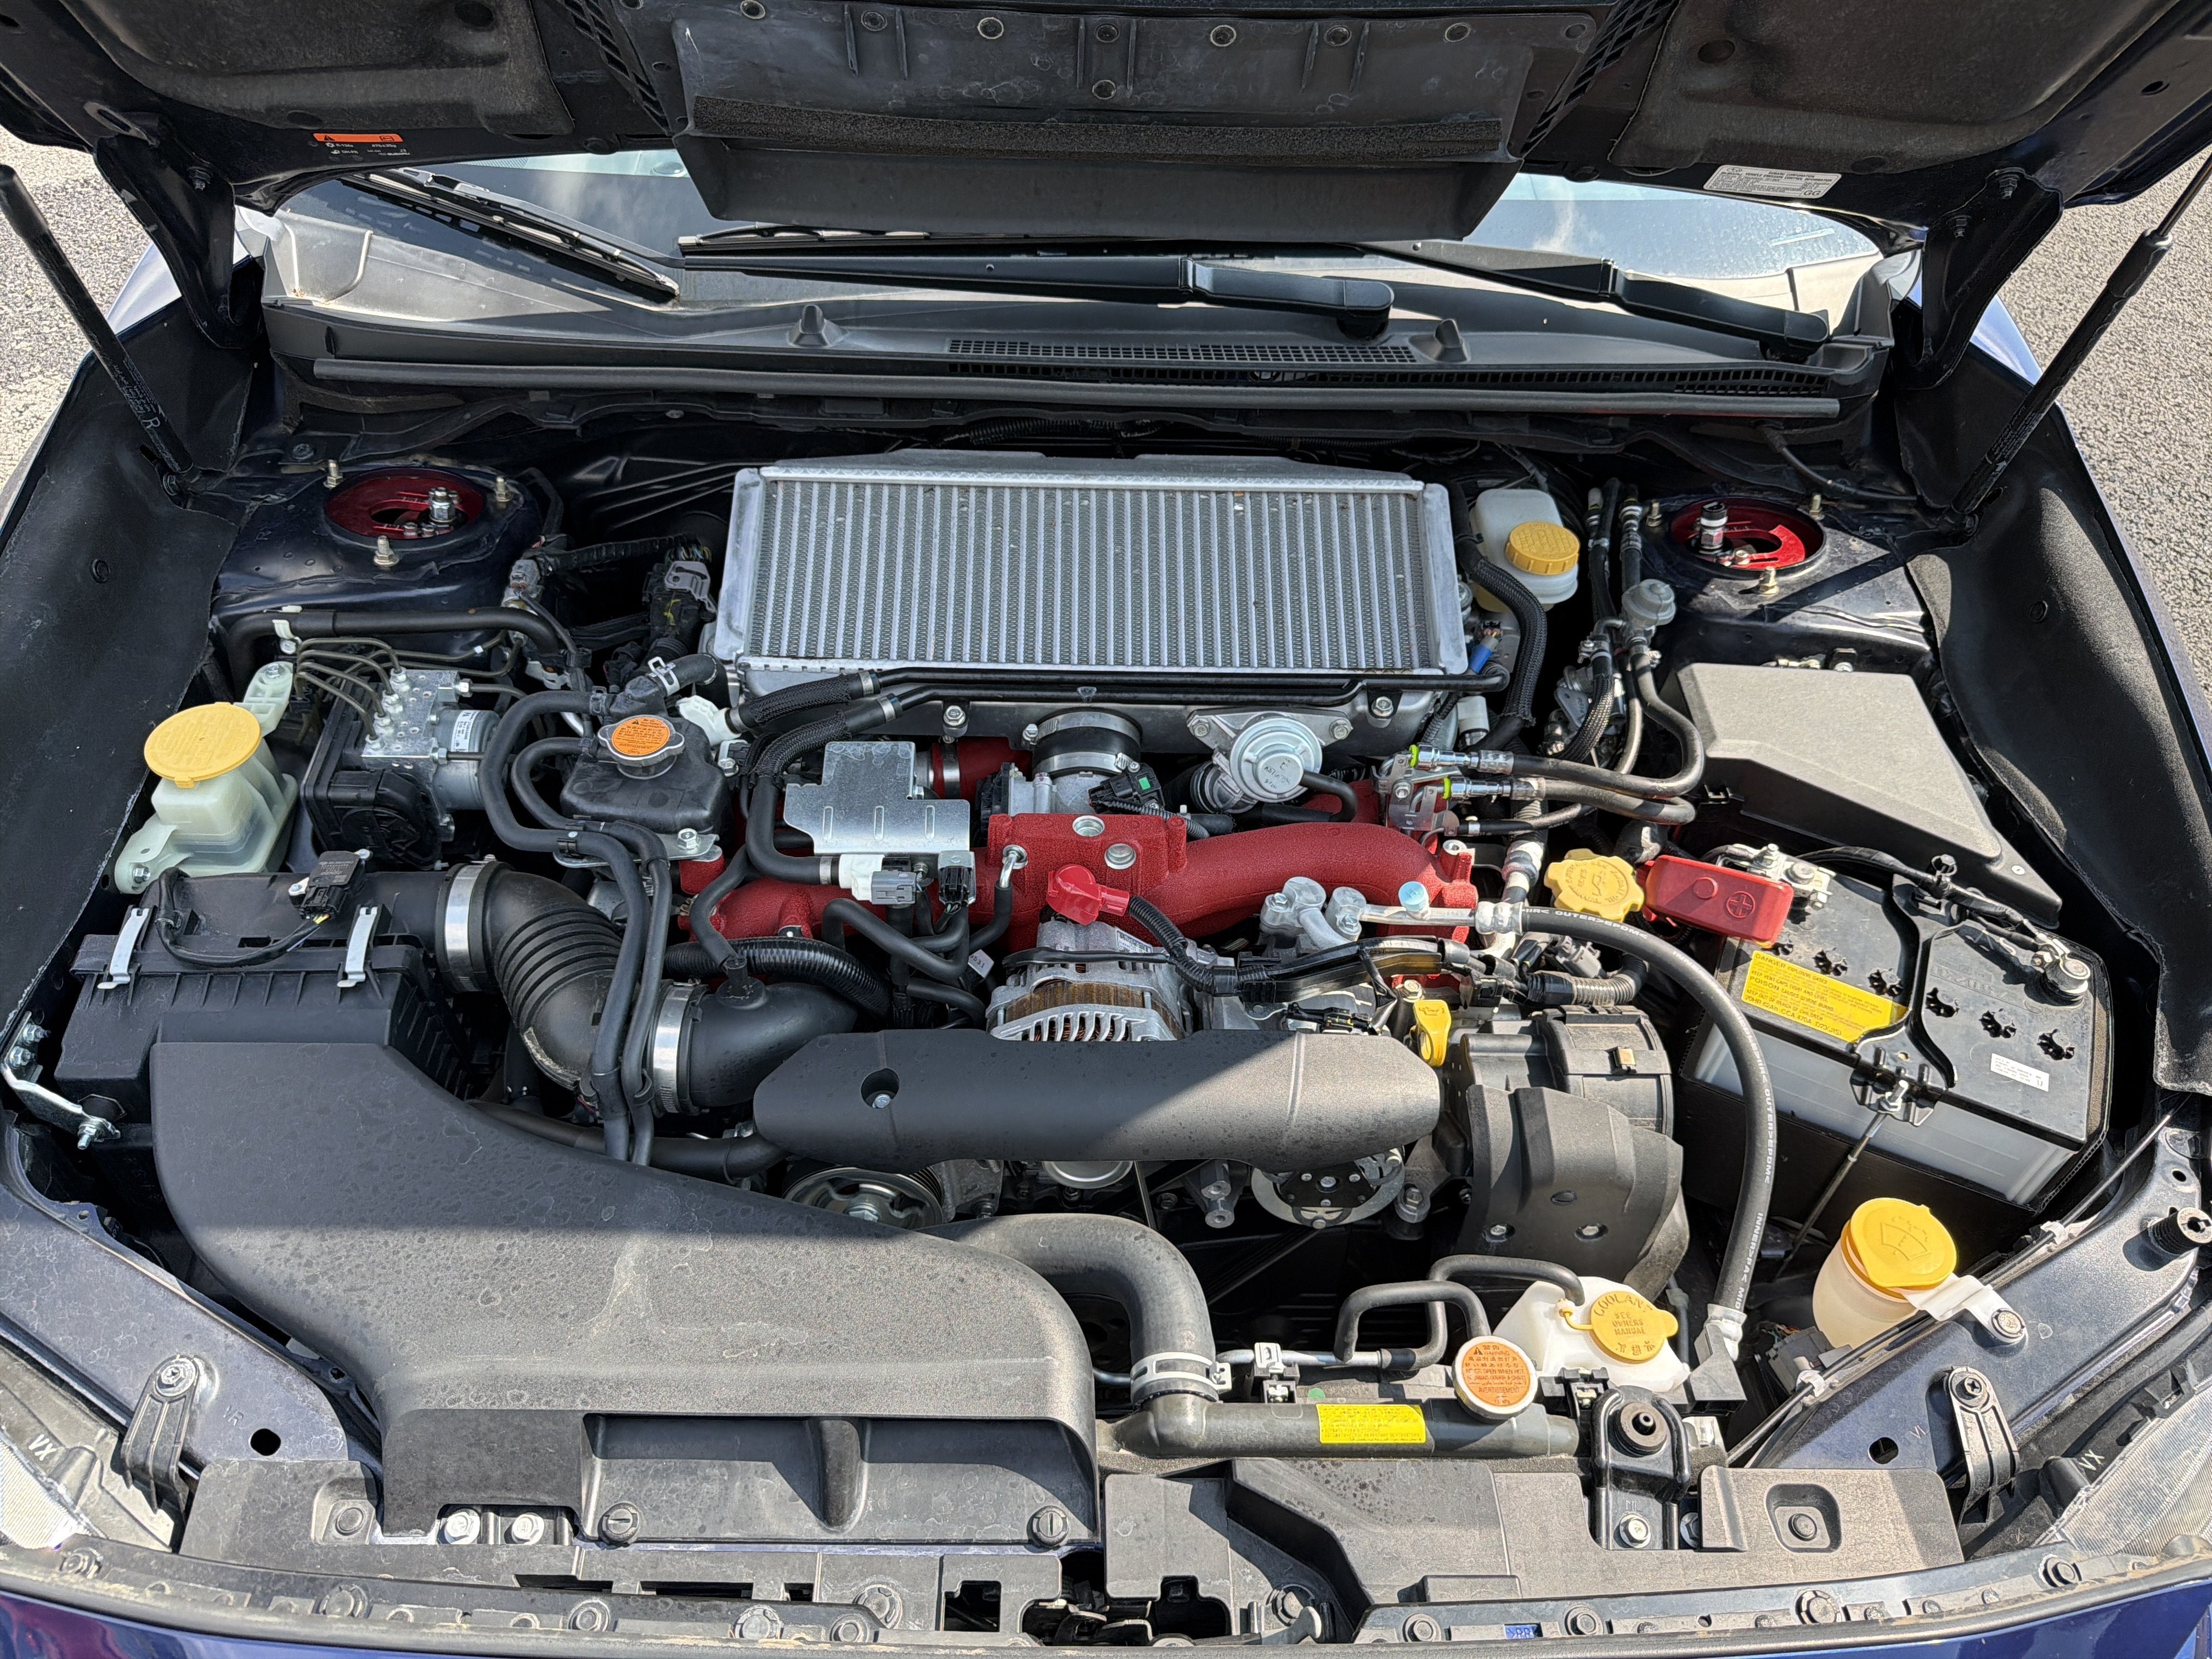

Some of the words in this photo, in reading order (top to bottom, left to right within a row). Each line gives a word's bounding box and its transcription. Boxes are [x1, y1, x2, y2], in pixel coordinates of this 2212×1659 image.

[1756, 953, 1786, 968] DANGER
[1750, 976, 1779, 990] POISON
[1781, 1008, 1795, 1018] CCA
[1764, 1088, 1775, 1184] OUTER>EPDM<
[1741, 1211, 1764, 1283] INNER>PA<
[1593, 1294, 1653, 1316] COOLANT
[1735, 1286, 1745, 1310] MID
[1612, 1319, 1644, 1327] OWNERS
[1614, 1327, 1646, 1335] MANUAL
[27, 1434, 57, 1461] VX
[2078, 1448, 2106, 1471] VX
